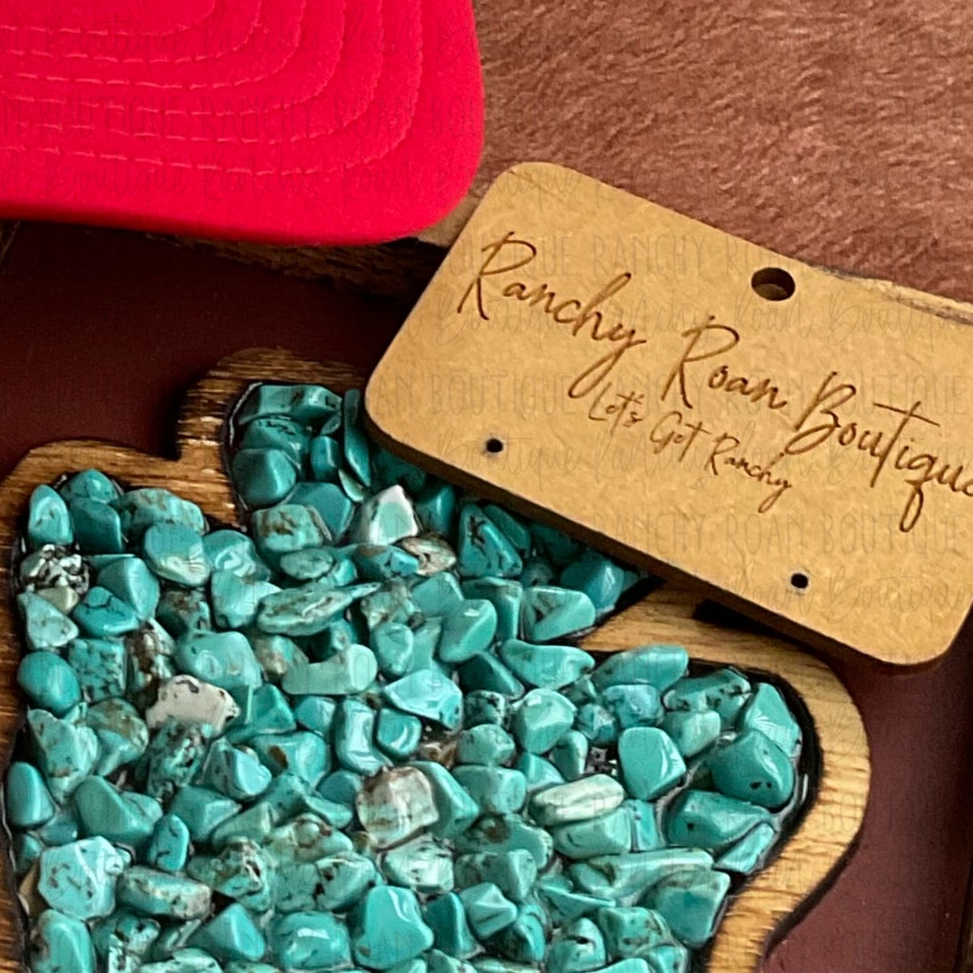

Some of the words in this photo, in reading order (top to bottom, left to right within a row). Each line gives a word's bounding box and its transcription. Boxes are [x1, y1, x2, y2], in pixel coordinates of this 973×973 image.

[457, 231, 647, 399] Ranchy
[660, 315, 788, 410] Roan
[704, 432, 792, 513] Ranchy
